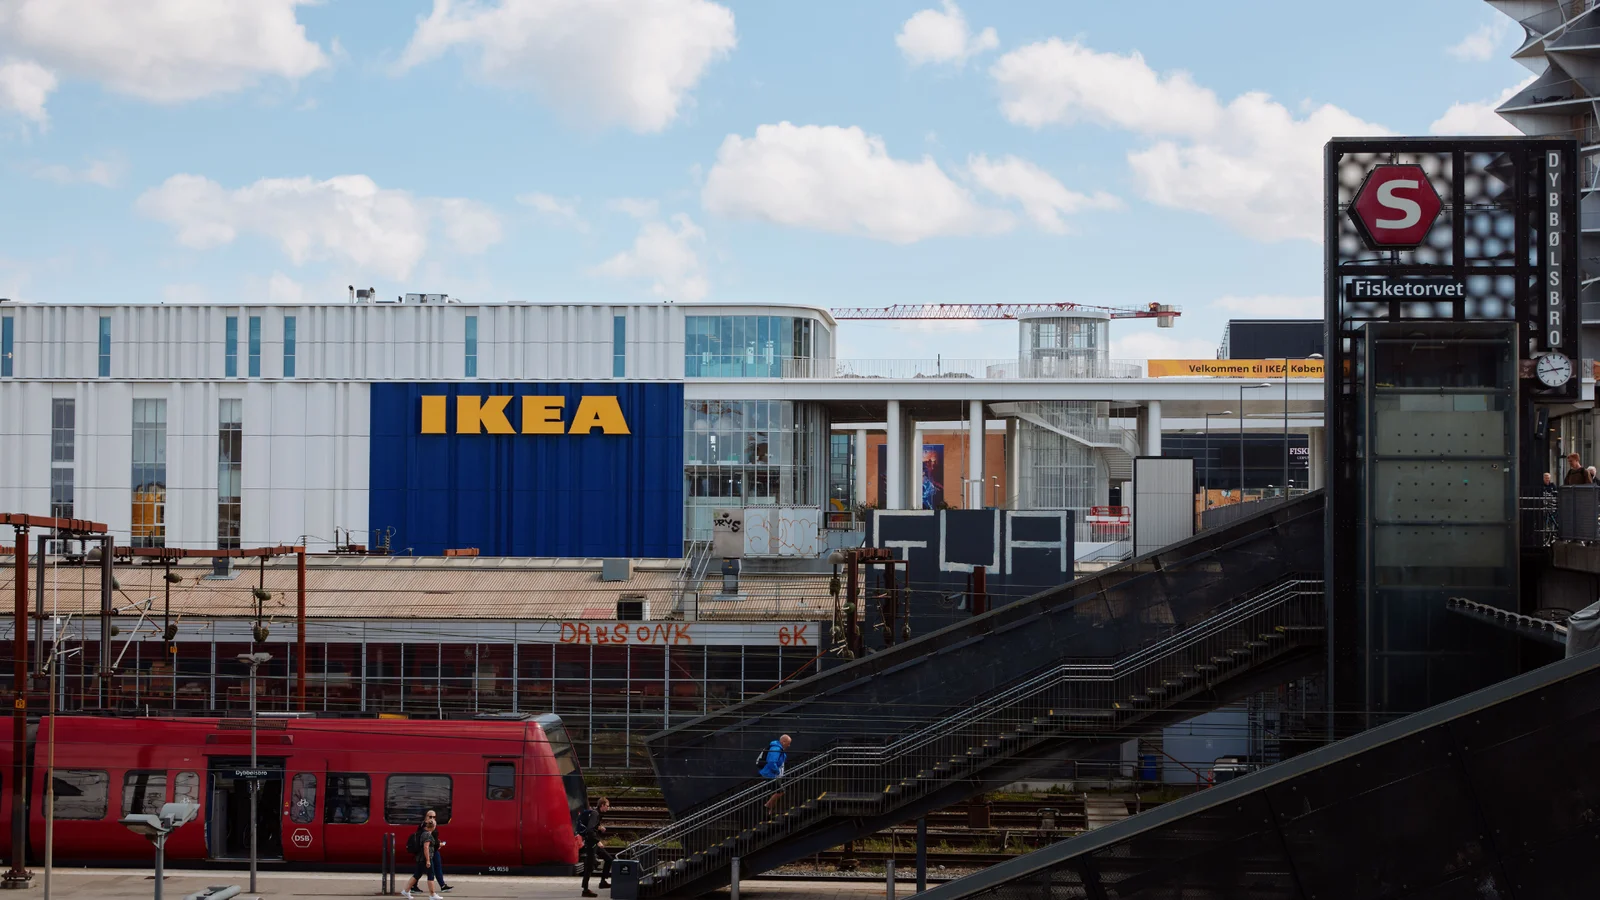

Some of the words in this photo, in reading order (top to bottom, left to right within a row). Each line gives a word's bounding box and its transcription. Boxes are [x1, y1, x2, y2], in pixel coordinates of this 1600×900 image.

[1376, 179, 1421, 229] S
[1549, 152, 1560, 346] DYBBØLSBRO
[1355, 280, 1464, 296] Fisketorvet
[1189, 364, 1249, 373] Velkommen
[1252, 364, 1262, 373] til
[1265, 364, 1287, 373] IKEA
[421, 395, 631, 434] IKEA
